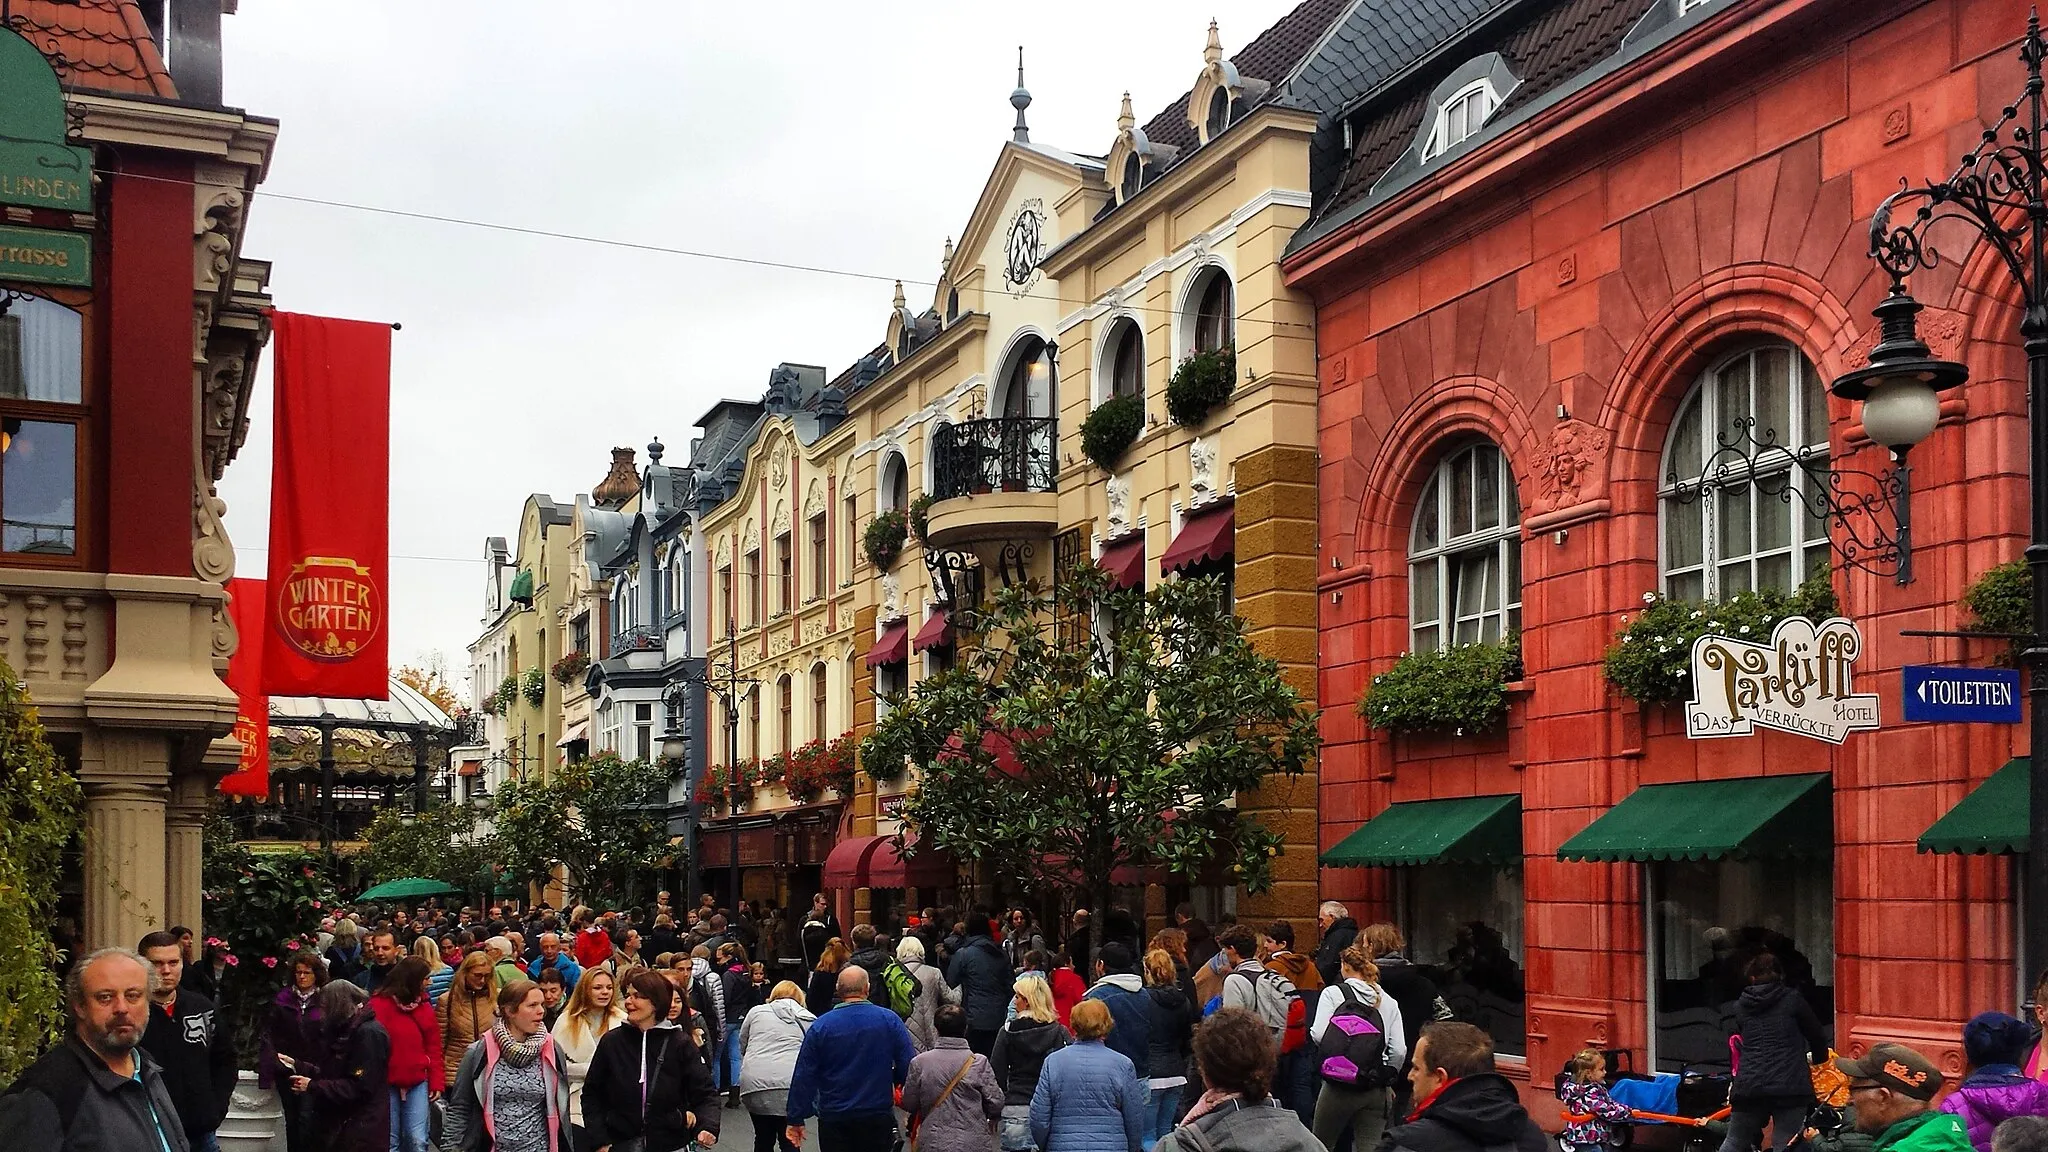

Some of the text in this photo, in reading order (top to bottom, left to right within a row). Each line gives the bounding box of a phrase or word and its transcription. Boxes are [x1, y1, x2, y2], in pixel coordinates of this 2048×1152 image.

[3, 174, 80, 200] LINDEN
[289, 577, 370, 608] WINTER
[288, 604, 371, 631] GARTEN
[1703, 631, 1856, 723] Tartüff
[1929, 680, 2011, 705] TOILETTEN
[1693, 704, 1875, 737] DAS VERRÜCKTE HOTEL
